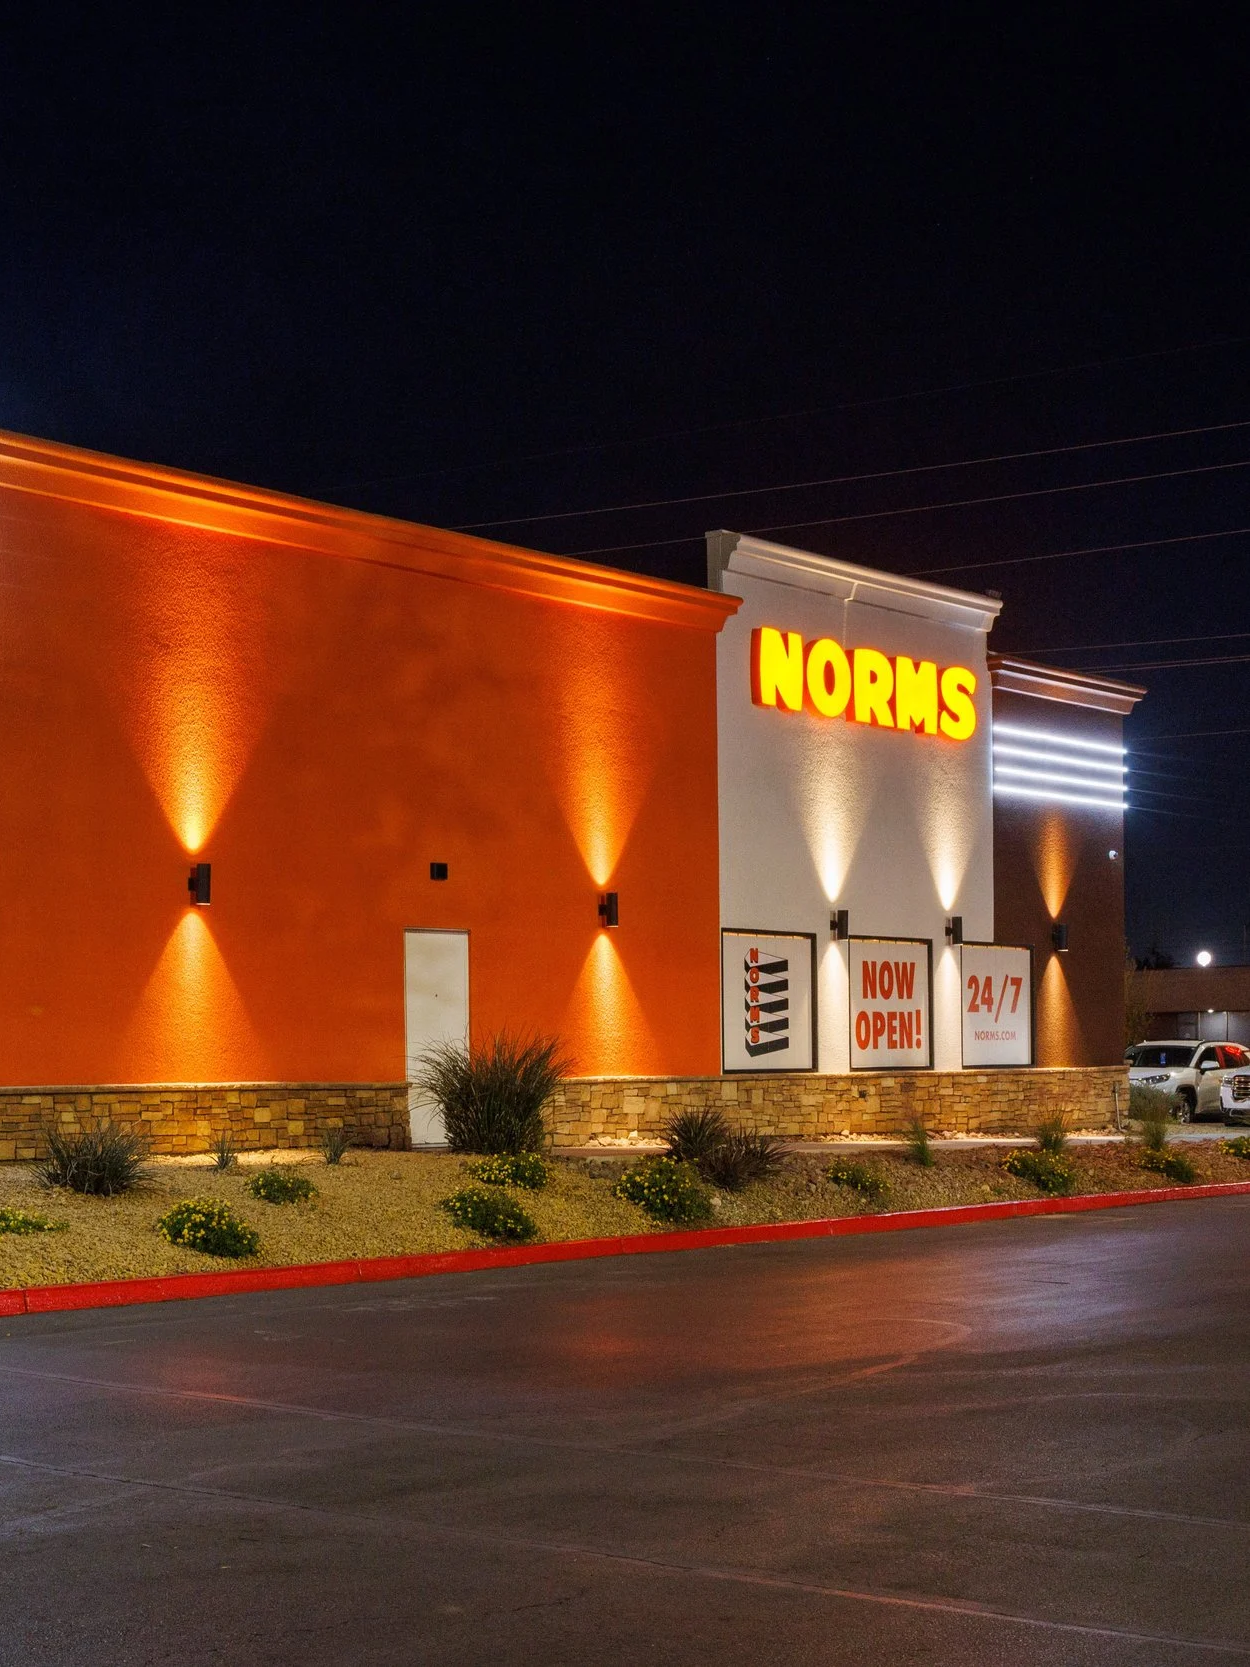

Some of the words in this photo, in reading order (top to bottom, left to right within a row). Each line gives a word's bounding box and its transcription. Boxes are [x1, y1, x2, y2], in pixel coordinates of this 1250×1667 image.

[754, 626, 977, 741] NORMS
[749, 947, 760, 1044] NORMS
[862, 960, 916, 999] NOW
[967, 974, 1023, 1023] 24/7
[855, 1009, 922, 1050] OPEN!
[974, 1030, 1017, 1041] NORMS.COM
